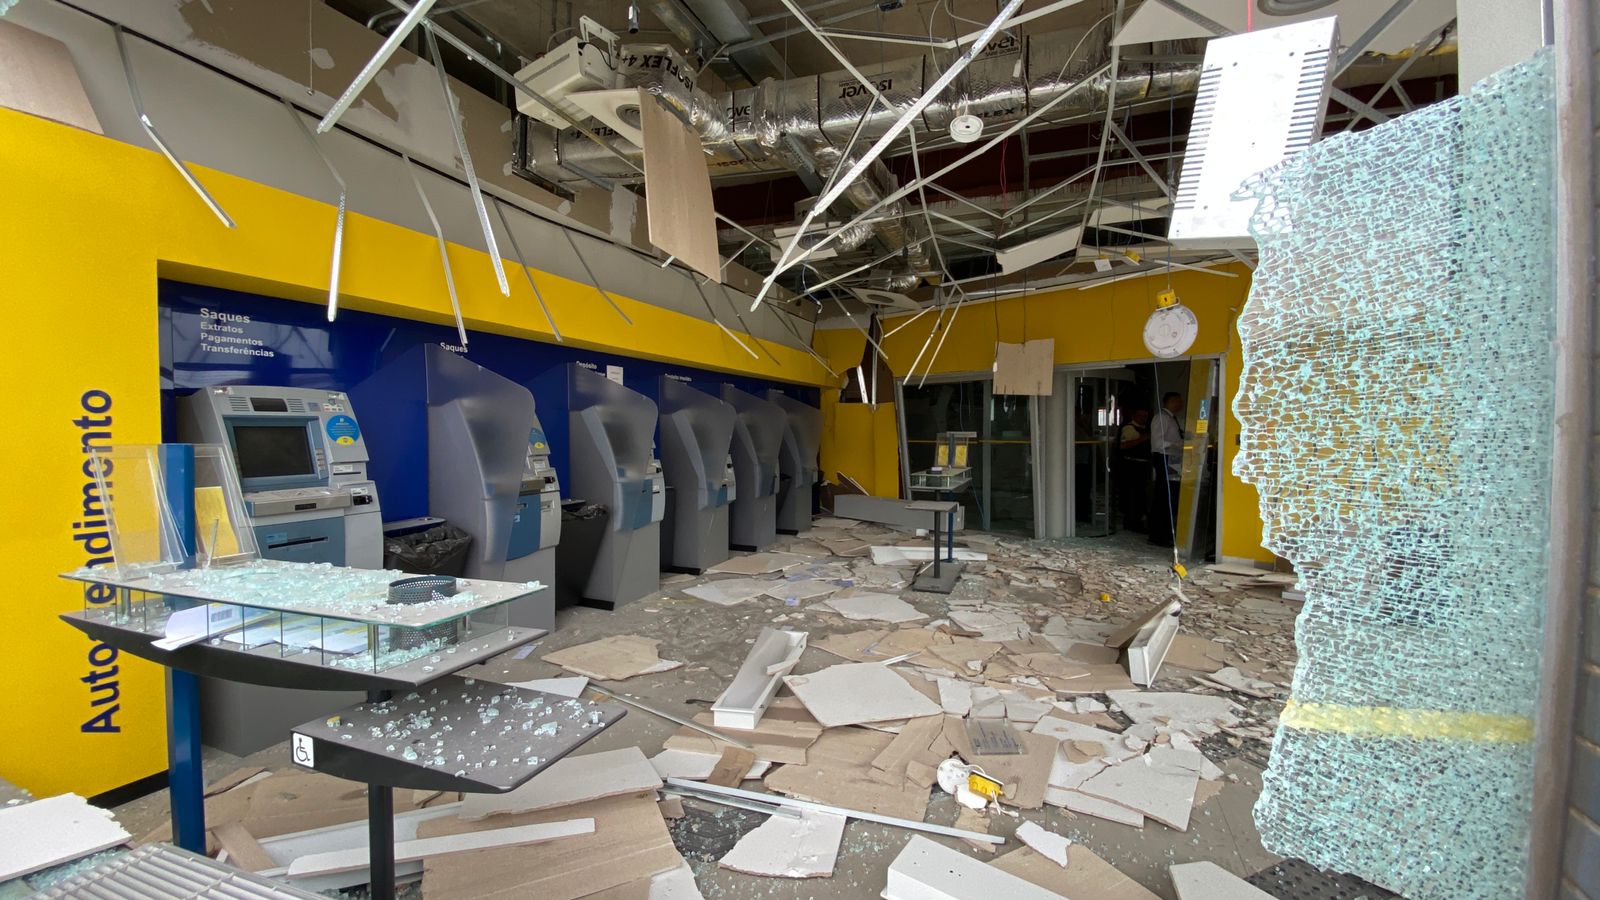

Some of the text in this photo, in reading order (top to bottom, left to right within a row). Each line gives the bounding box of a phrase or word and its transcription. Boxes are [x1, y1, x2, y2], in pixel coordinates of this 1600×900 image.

[200, 307, 251, 324] Saques
[200, 321, 244, 334] Extratos
[200, 332, 264, 347] Pagamentos
[440, 341, 468, 353] Saques
[200, 343, 275, 358] Transferências
[72, 389, 121, 733] Autoendimento
